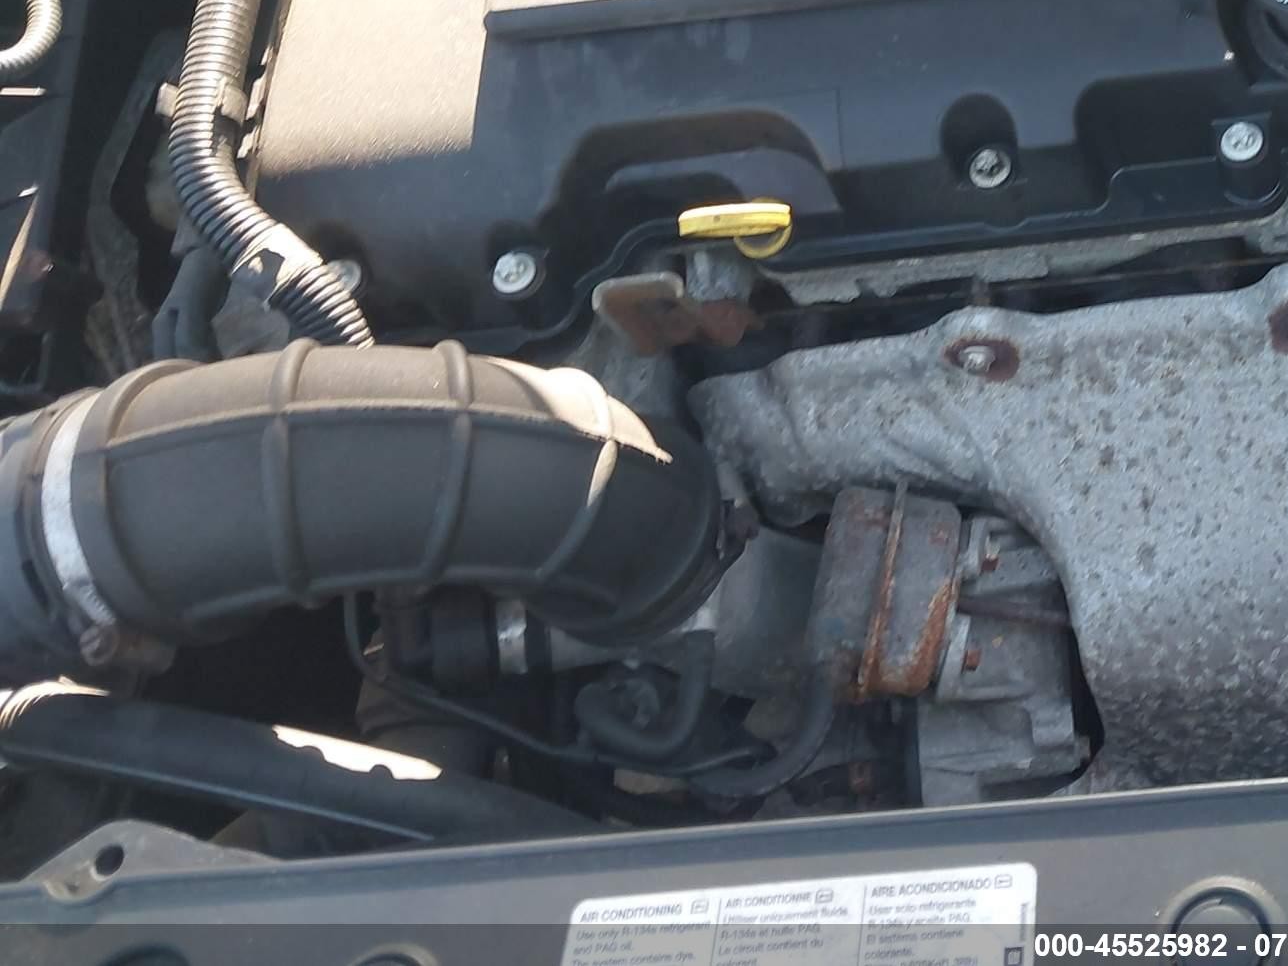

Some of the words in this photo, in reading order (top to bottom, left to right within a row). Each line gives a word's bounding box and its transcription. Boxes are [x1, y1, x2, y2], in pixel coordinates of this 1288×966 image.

[871, 885, 895, 897] AIRE
[898, 877, 991, 895] ACONDICIONADO
[726, 897, 741, 907] AIR
[580, 910, 600, 922] AIR
[600, 903, 683, 920] CONDITIONING
[576, 929, 596, 939] Use
[597, 927, 620, 940] only
[920, 927, 964, 940] contiene
[810, 938, 824, 947] du
[573, 944, 593, 954] and
[630, 953, 673, 964] contains
